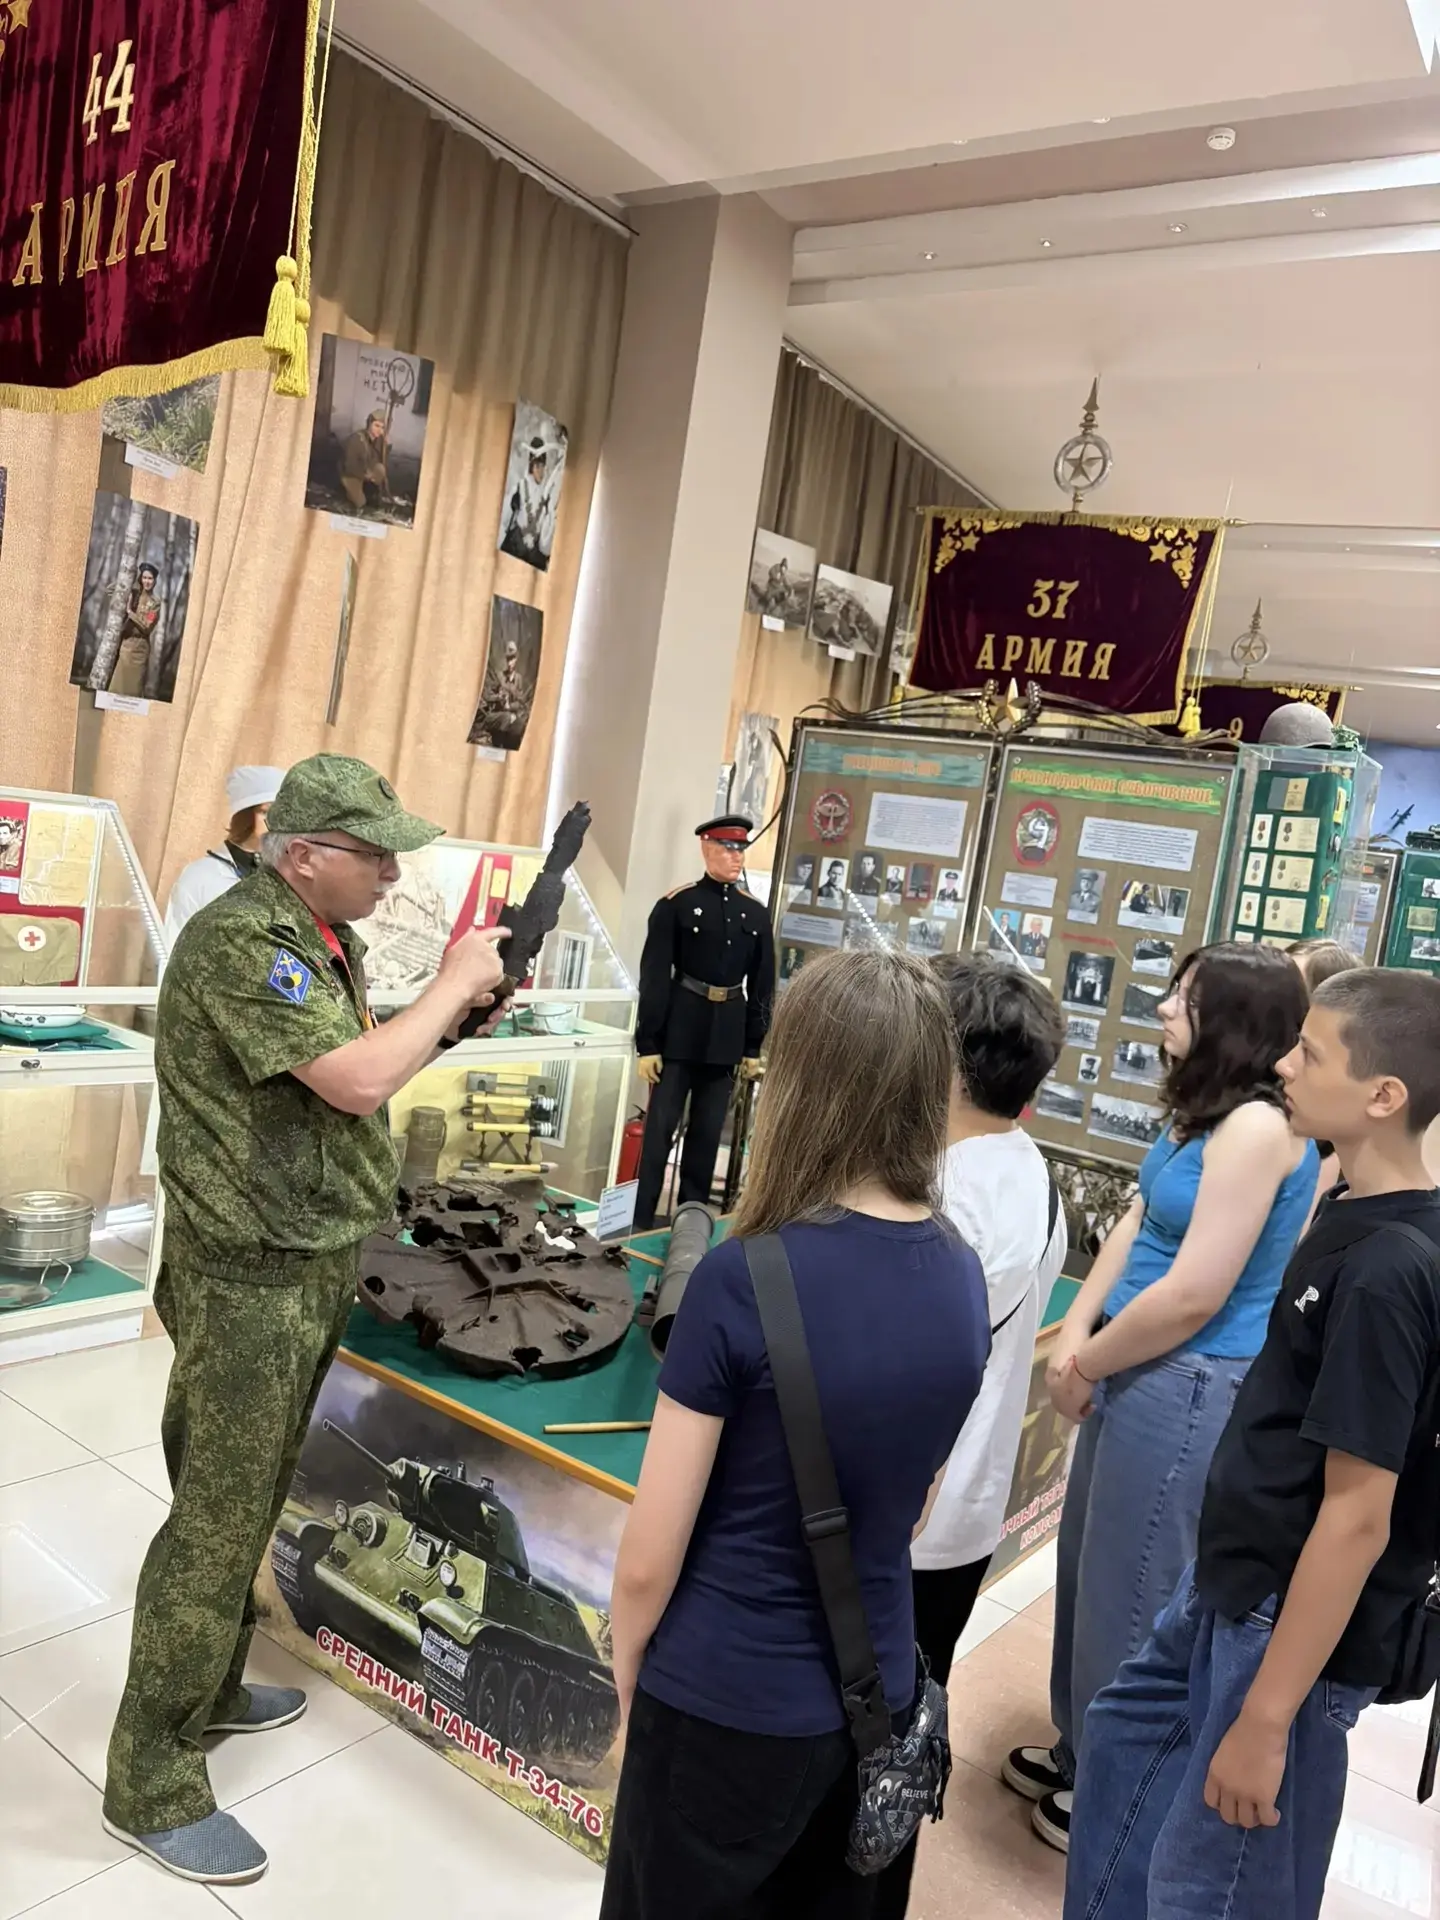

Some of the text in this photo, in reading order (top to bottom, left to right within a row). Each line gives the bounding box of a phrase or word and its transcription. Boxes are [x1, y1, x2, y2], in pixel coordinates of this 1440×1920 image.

[82, 39, 136, 146] 44
[12, 159, 176, 287] АРМИЯ
[1026, 578, 1080, 619] 37
[975, 633, 1117, 680] АРМИЯ
[1227, 717, 1244, 741] 9
[316, 1626, 604, 1836] СРЕДНИЙ ТАНК Т-34-76
[901, 1788, 929, 1799] BELIEVE
